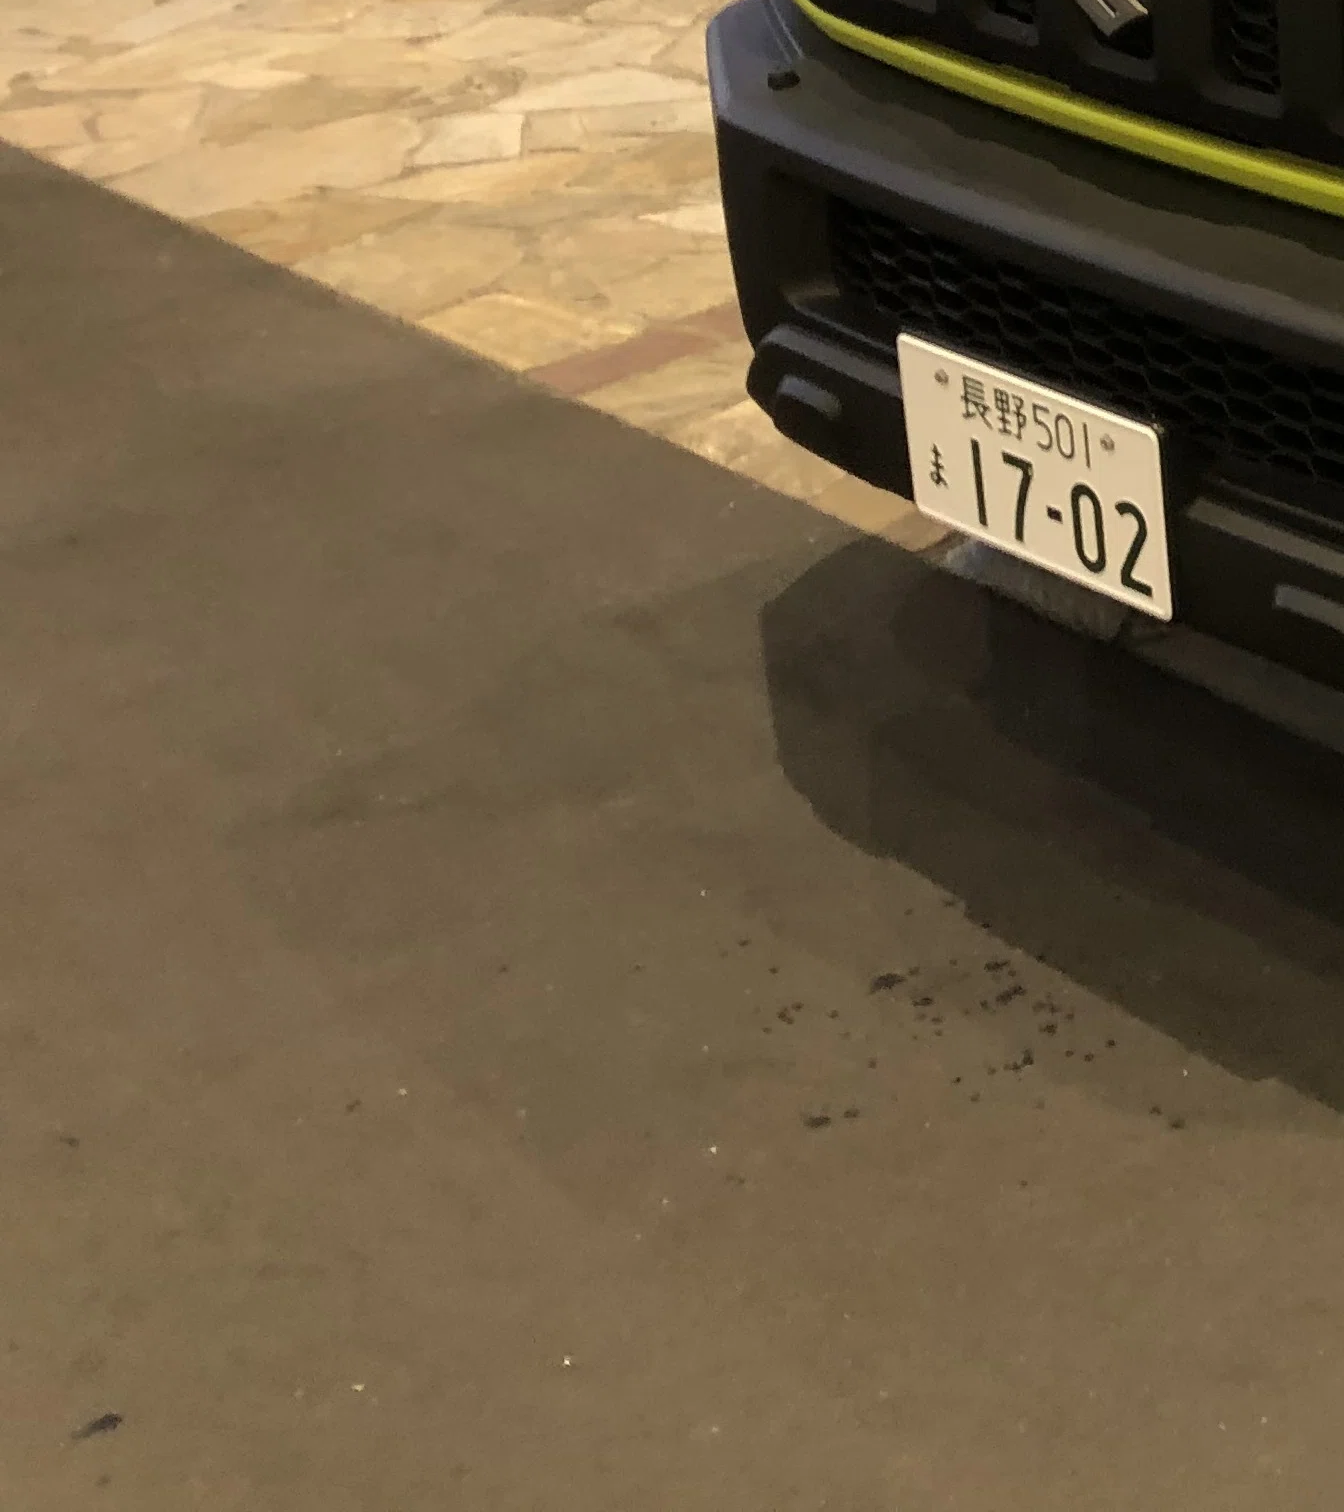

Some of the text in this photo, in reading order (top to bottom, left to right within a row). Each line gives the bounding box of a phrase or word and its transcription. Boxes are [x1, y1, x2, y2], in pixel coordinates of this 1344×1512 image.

[961, 374, 1092, 469] 長野501
[929, 437, 1153, 597] ま 17-02
